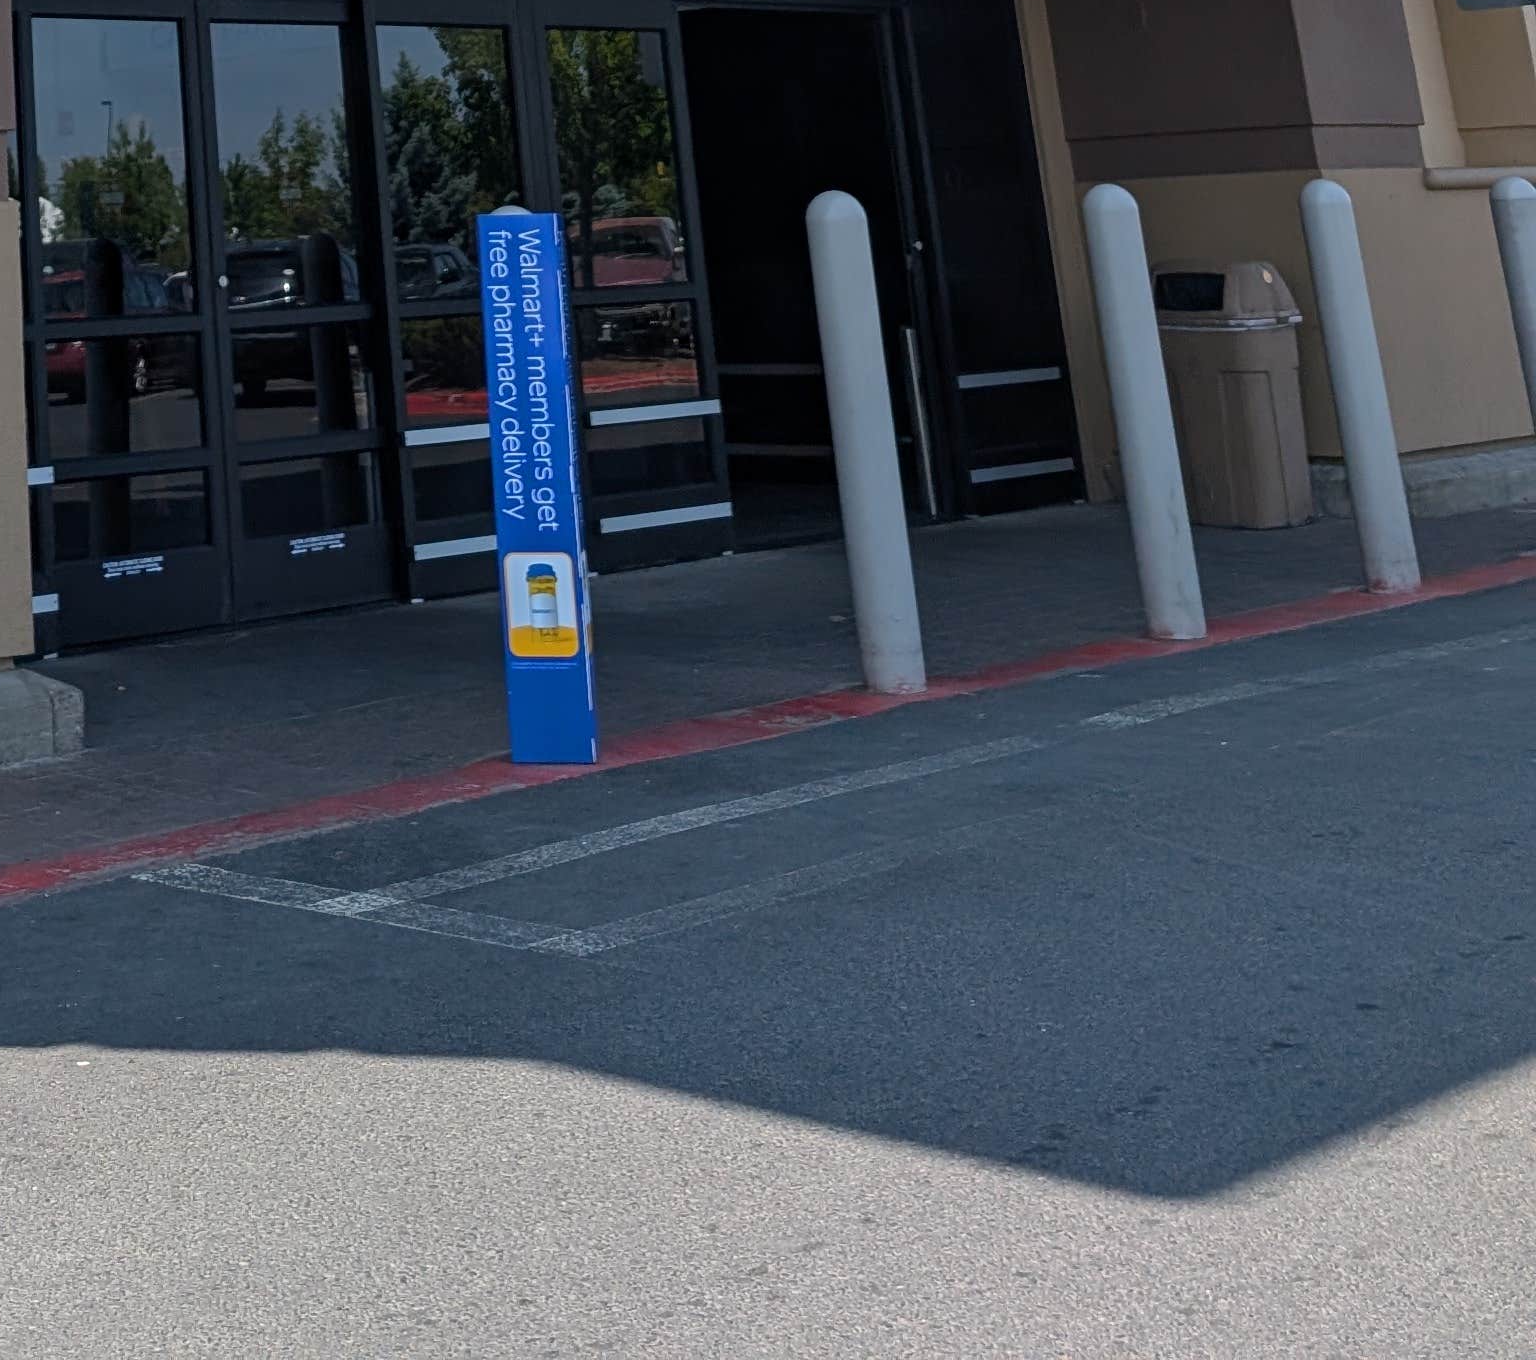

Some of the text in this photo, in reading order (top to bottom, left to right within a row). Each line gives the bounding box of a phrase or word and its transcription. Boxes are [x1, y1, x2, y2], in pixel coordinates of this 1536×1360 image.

[486, 229, 528, 520] free pharmacy delivery
[517, 228, 561, 531] Walmart+ members get
